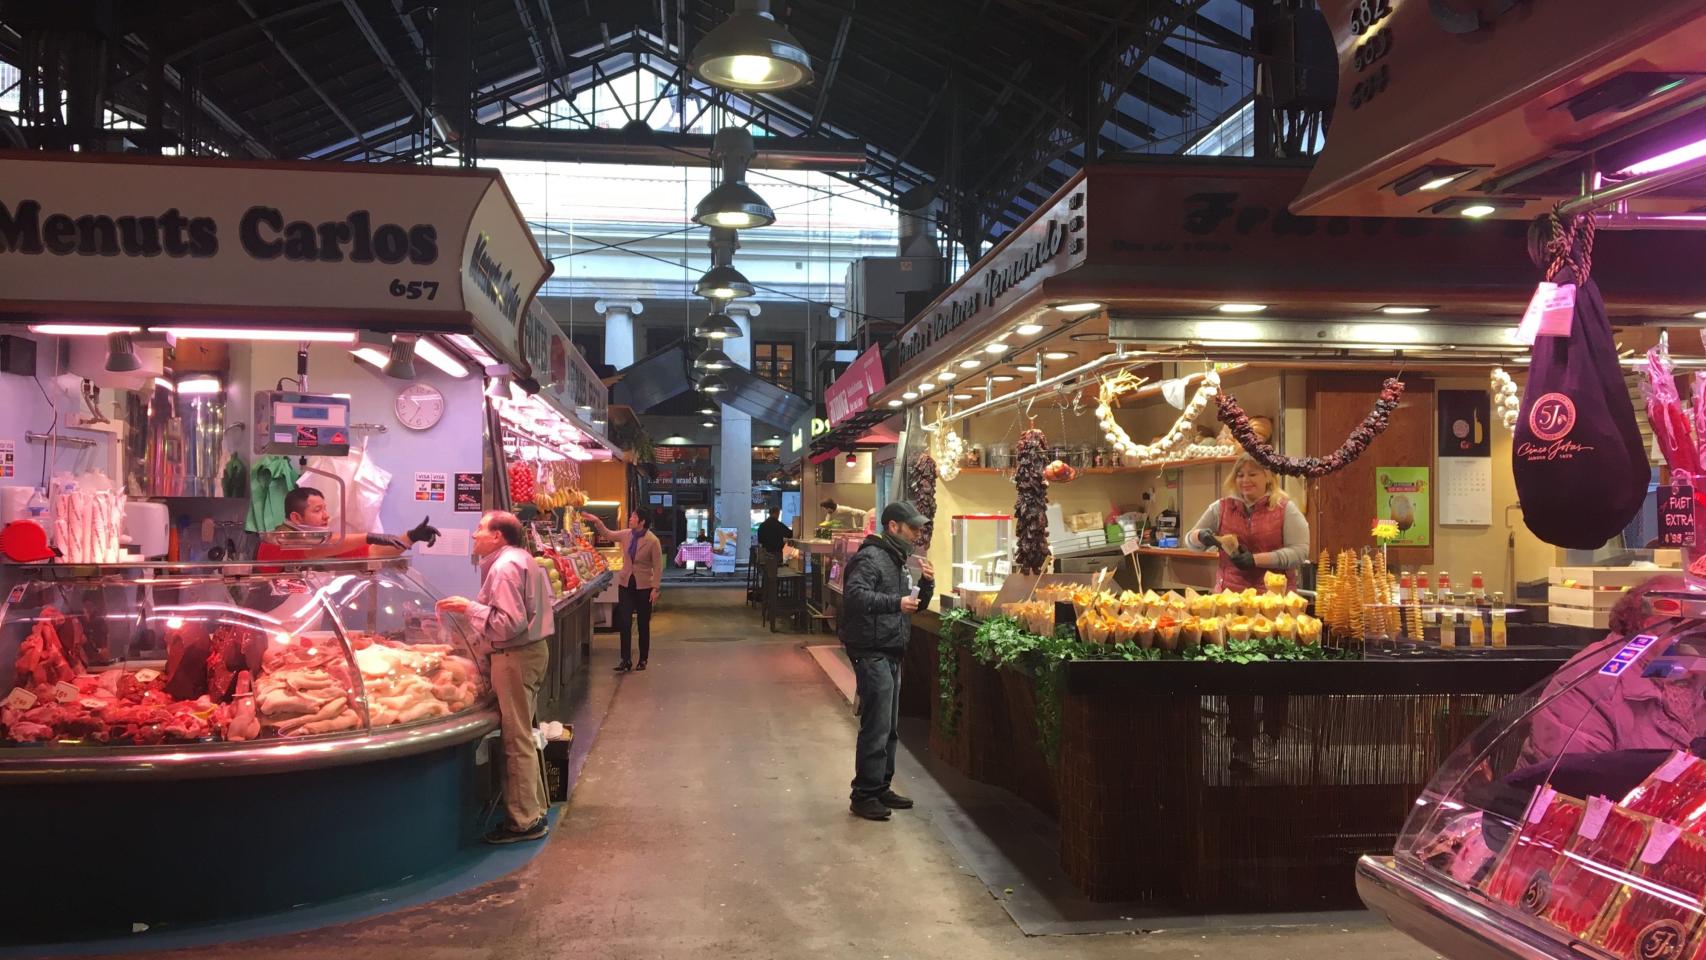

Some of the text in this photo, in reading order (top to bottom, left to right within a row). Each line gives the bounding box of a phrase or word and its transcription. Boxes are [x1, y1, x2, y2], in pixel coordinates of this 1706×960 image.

[0, 200, 438, 264] Menuts Carlos
[983, 219, 1069, 307] Hernando
[389, 278, 439, 301] 657
[1517, 442, 1548, 457] Cinco
[1669, 496, 1692, 510] FUET
[1665, 513, 1694, 527] EXTRA
[1645, 930, 1676, 958] 5J
